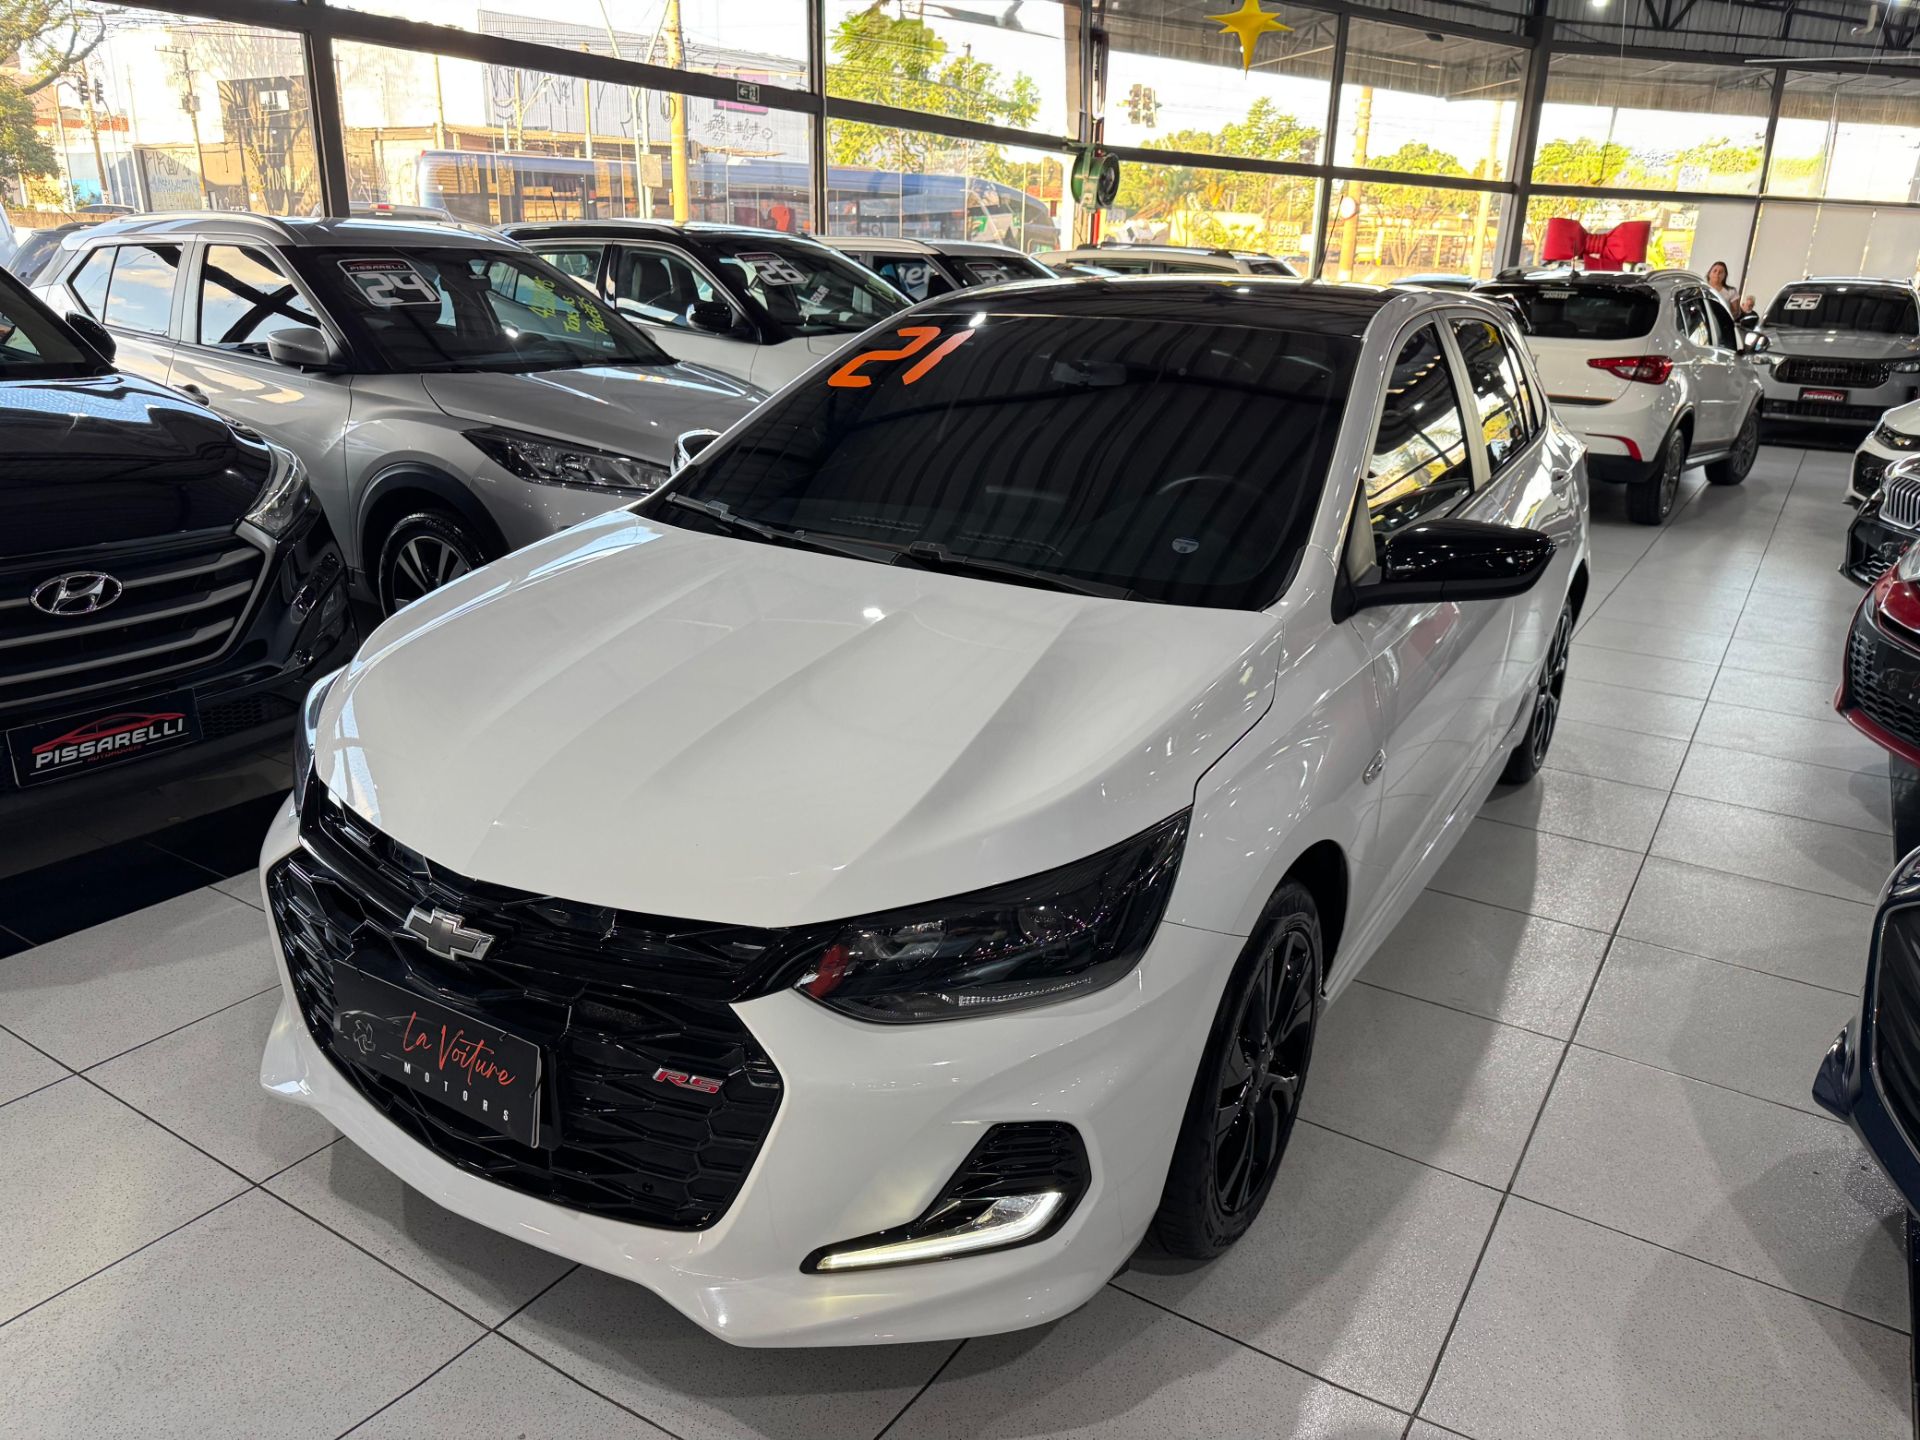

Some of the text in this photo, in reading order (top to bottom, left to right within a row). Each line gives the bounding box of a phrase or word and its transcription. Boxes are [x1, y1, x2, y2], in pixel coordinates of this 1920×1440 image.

[356, 273, 437, 304] 24
[753, 261, 805, 284] 26
[1786, 297, 1817, 310] 26
[827, 326, 976, 388] 21
[35, 718, 183, 769] PISSARELLI
[403, 1011, 516, 1086] La Voiture
[403, 1061, 509, 1122] MOTORS
[652, 1067, 724, 1094] RS
